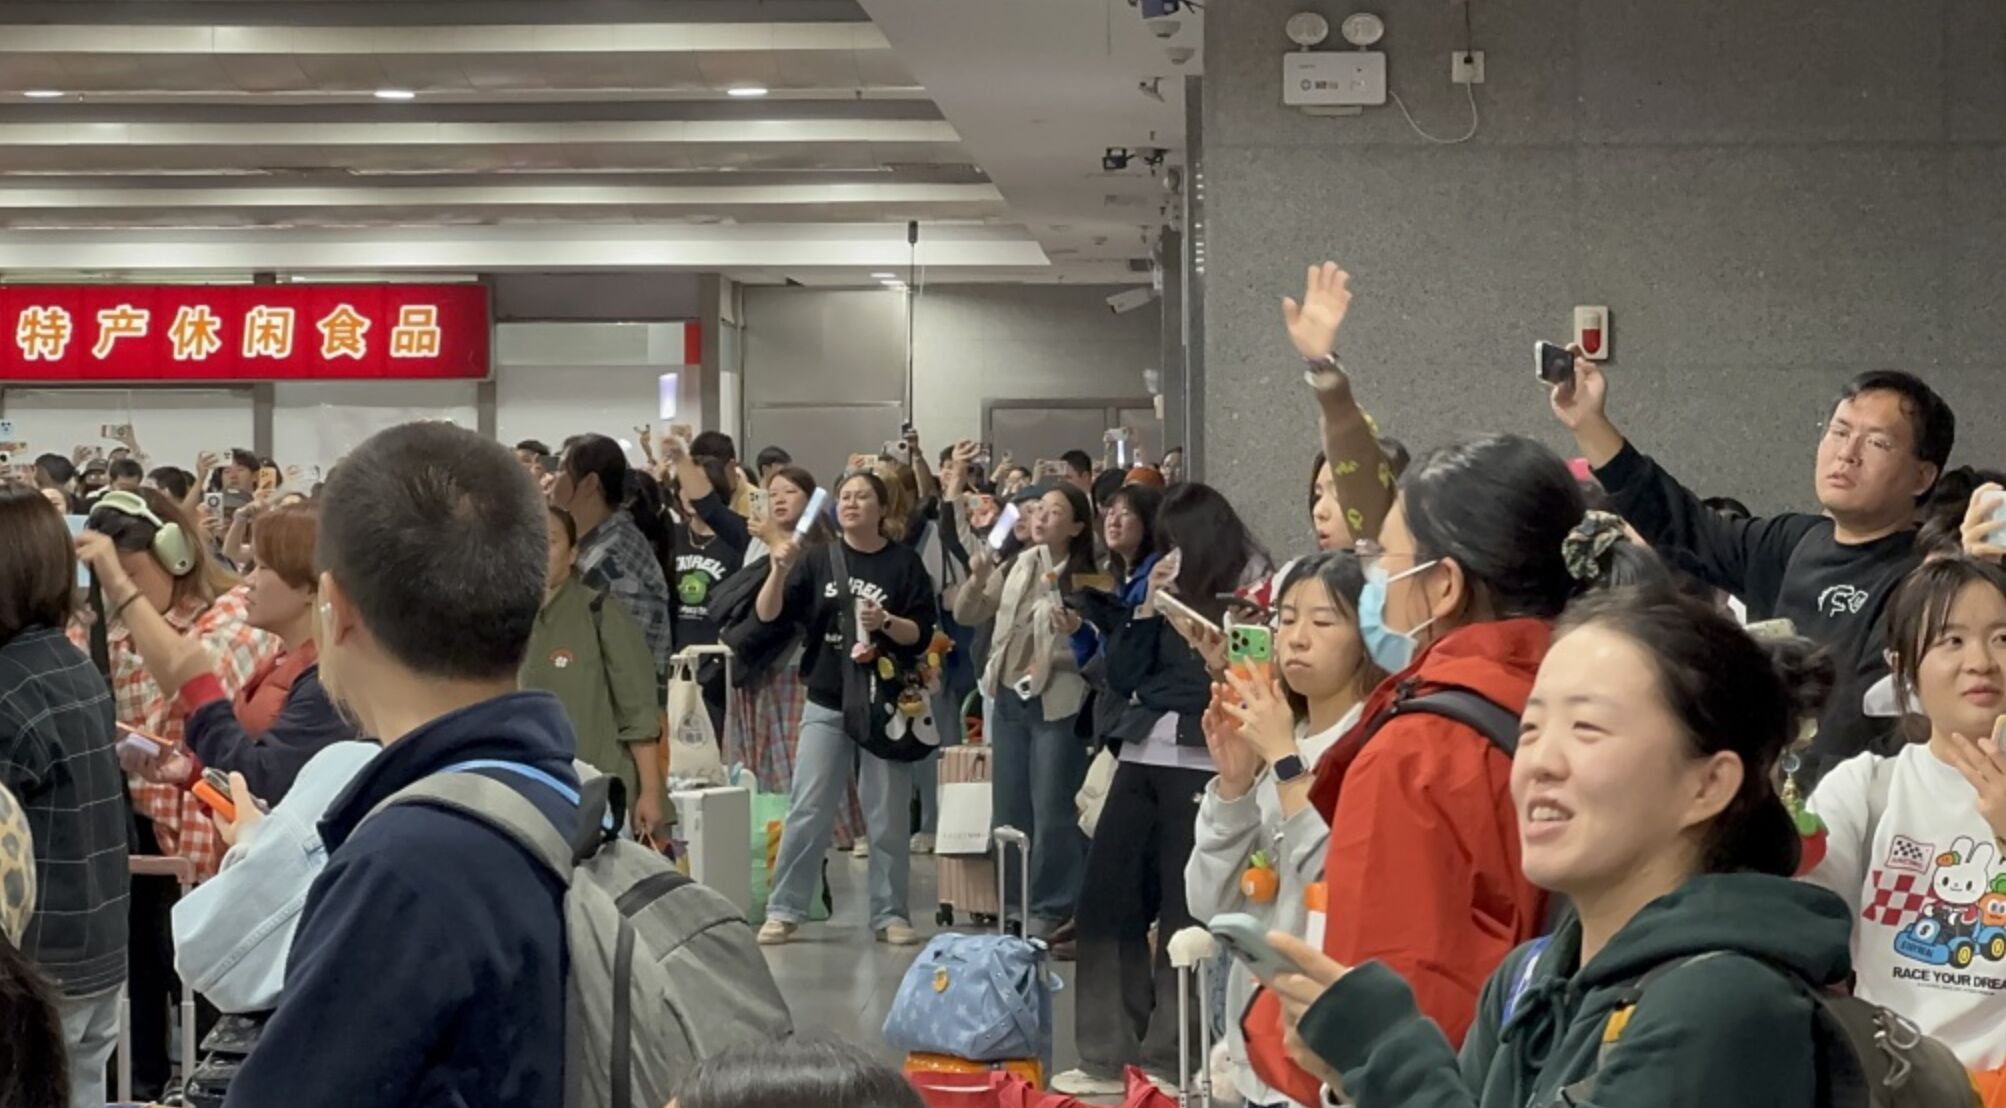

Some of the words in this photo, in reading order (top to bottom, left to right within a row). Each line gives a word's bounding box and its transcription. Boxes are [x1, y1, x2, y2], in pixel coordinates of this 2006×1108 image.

[17, 305, 441, 360] 特产休闲食品
[824, 576, 888, 608] SREAL
[1892, 966, 1930, 981] RACE
[1932, 971, 1971, 986] YOUR
